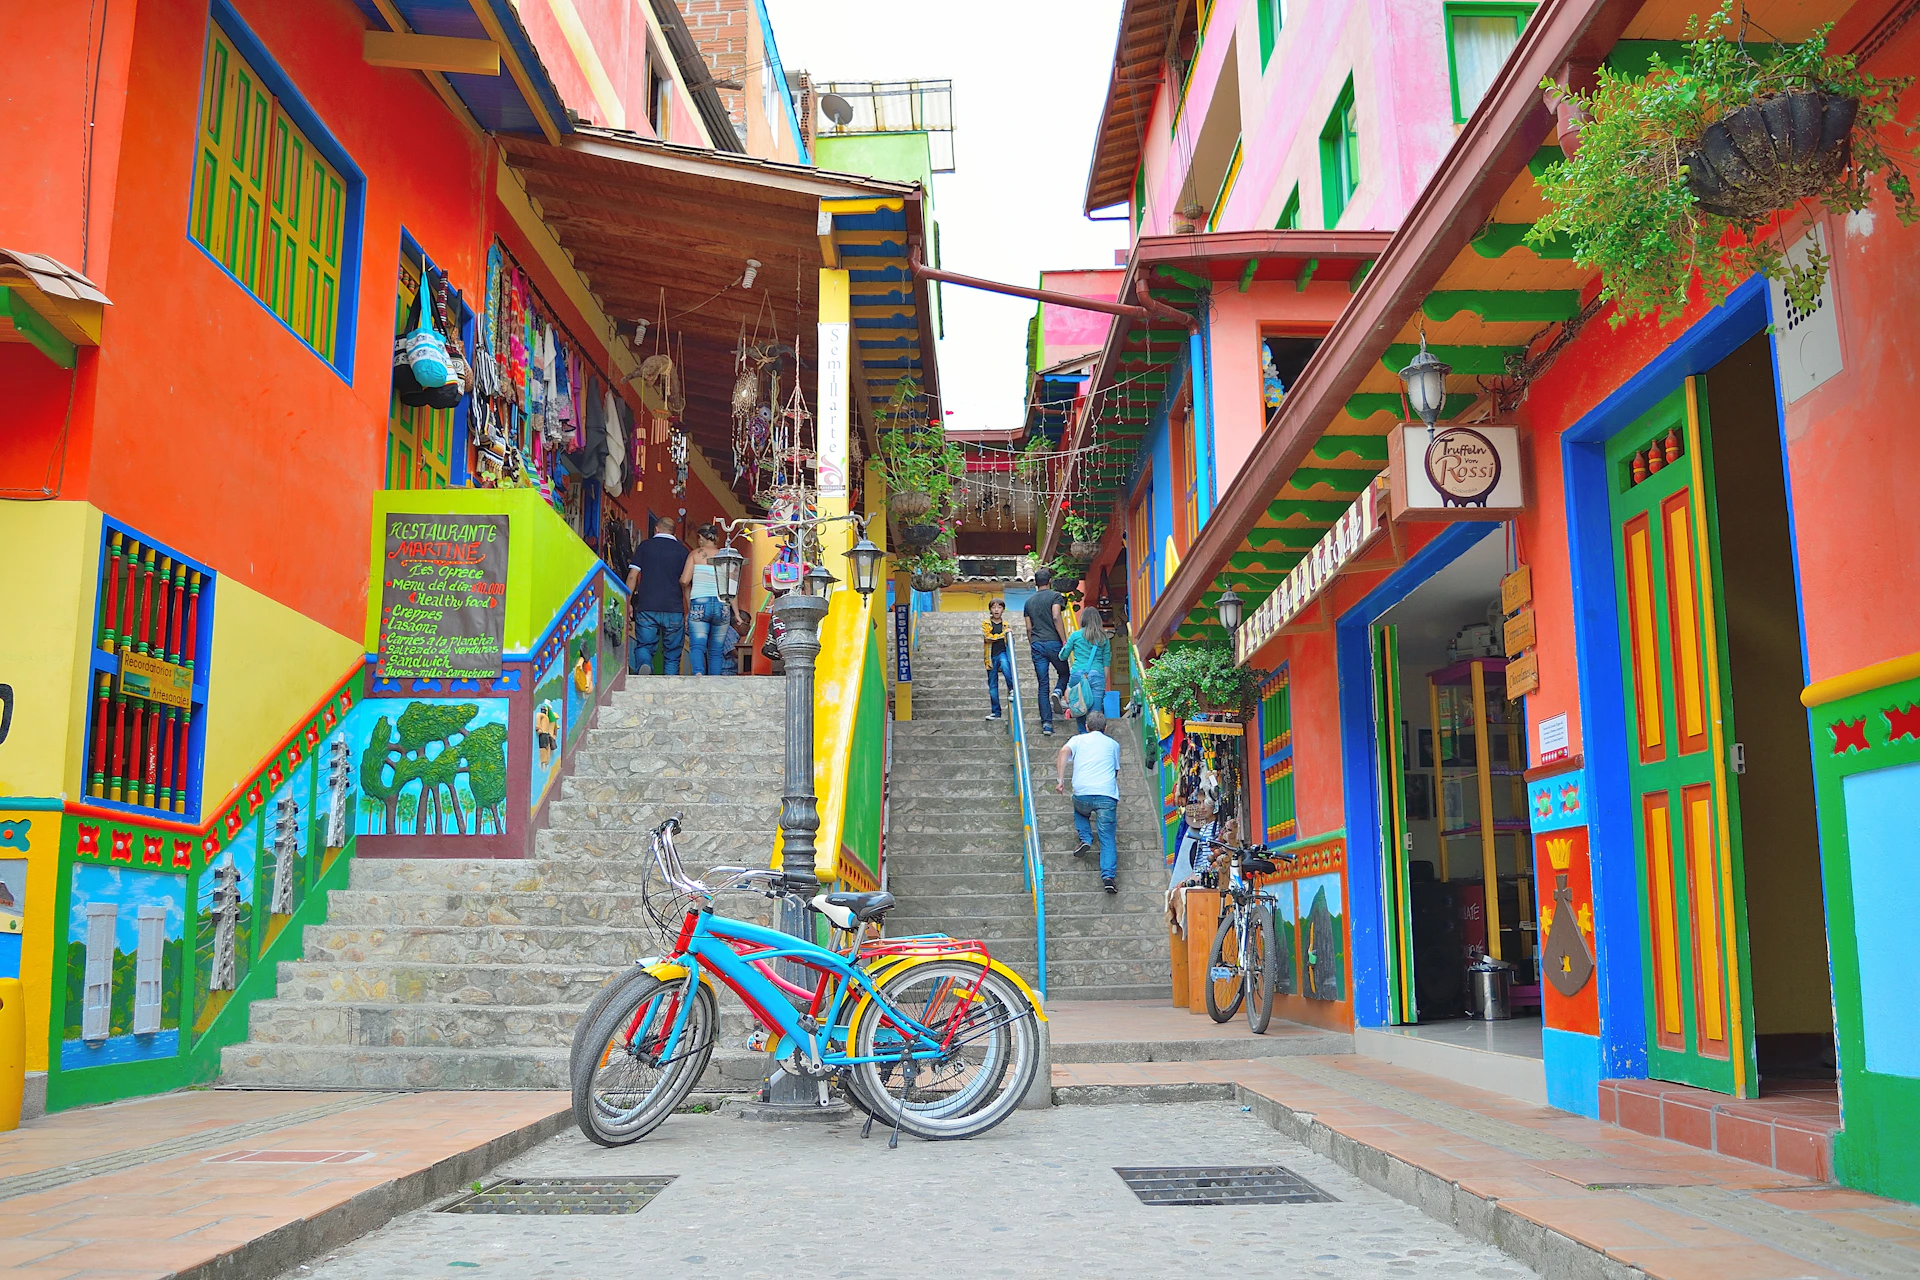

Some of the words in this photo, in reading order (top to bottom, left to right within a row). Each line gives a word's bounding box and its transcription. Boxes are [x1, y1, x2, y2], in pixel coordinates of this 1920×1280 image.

[828, 328, 841, 453] Semillarte
[1440, 437, 1487, 456] Truffeln
[389, 522, 497, 542] RESTAURANTE
[388, 541, 481, 560] MARTINE
[392, 579, 425, 592] Menu
[428, 579, 447, 592] del
[416, 593, 463, 611] Healthy
[464, 594, 491, 609] food
[392, 604, 443, 622] Creppes
[387, 616, 438, 636] Lasagna
[386, 632, 425, 646] Carnes
[426, 636, 435, 646] a
[435, 635, 448, 648] la
[898, 606, 908, 681] RESTAURANTE
[385, 645, 437, 656] Salteado
[437, 646, 451, 655] de
[124, 653, 173, 678] Recordatorios
[387, 654, 452, 669] Sandwich
[151, 687, 190, 706] Artesanales
